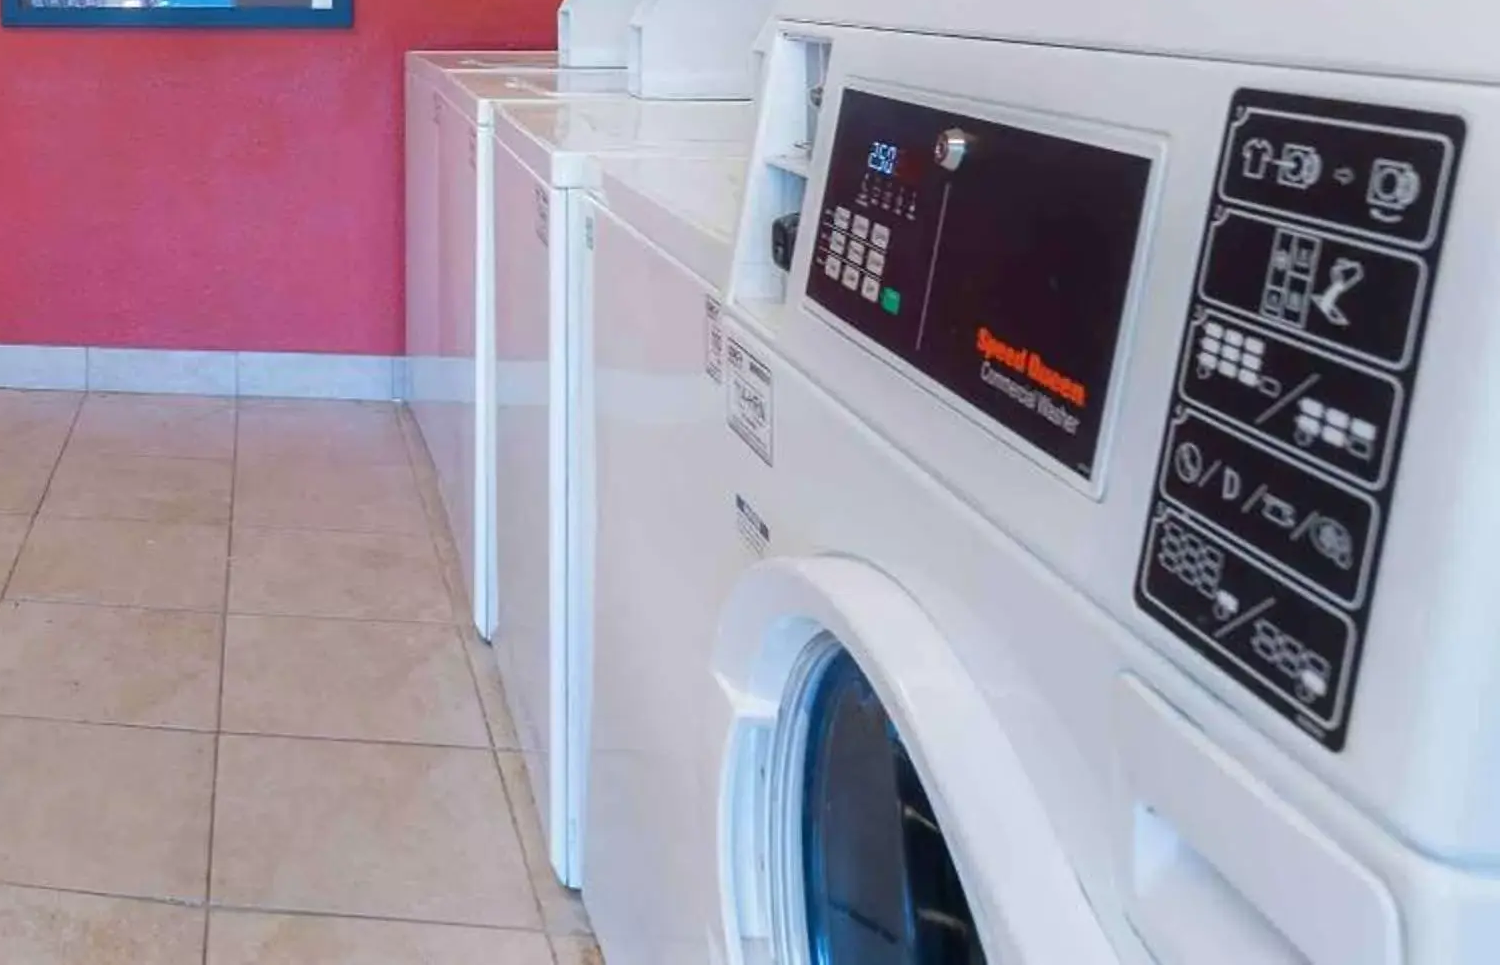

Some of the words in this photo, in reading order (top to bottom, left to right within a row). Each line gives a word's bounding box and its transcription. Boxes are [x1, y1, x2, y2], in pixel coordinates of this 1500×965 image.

[976, 326, 1029, 374] Speed
[1027, 352, 1086, 408] Queen
[980, 361, 1037, 409] Commercial
[1036, 391, 1081, 436] Washer
